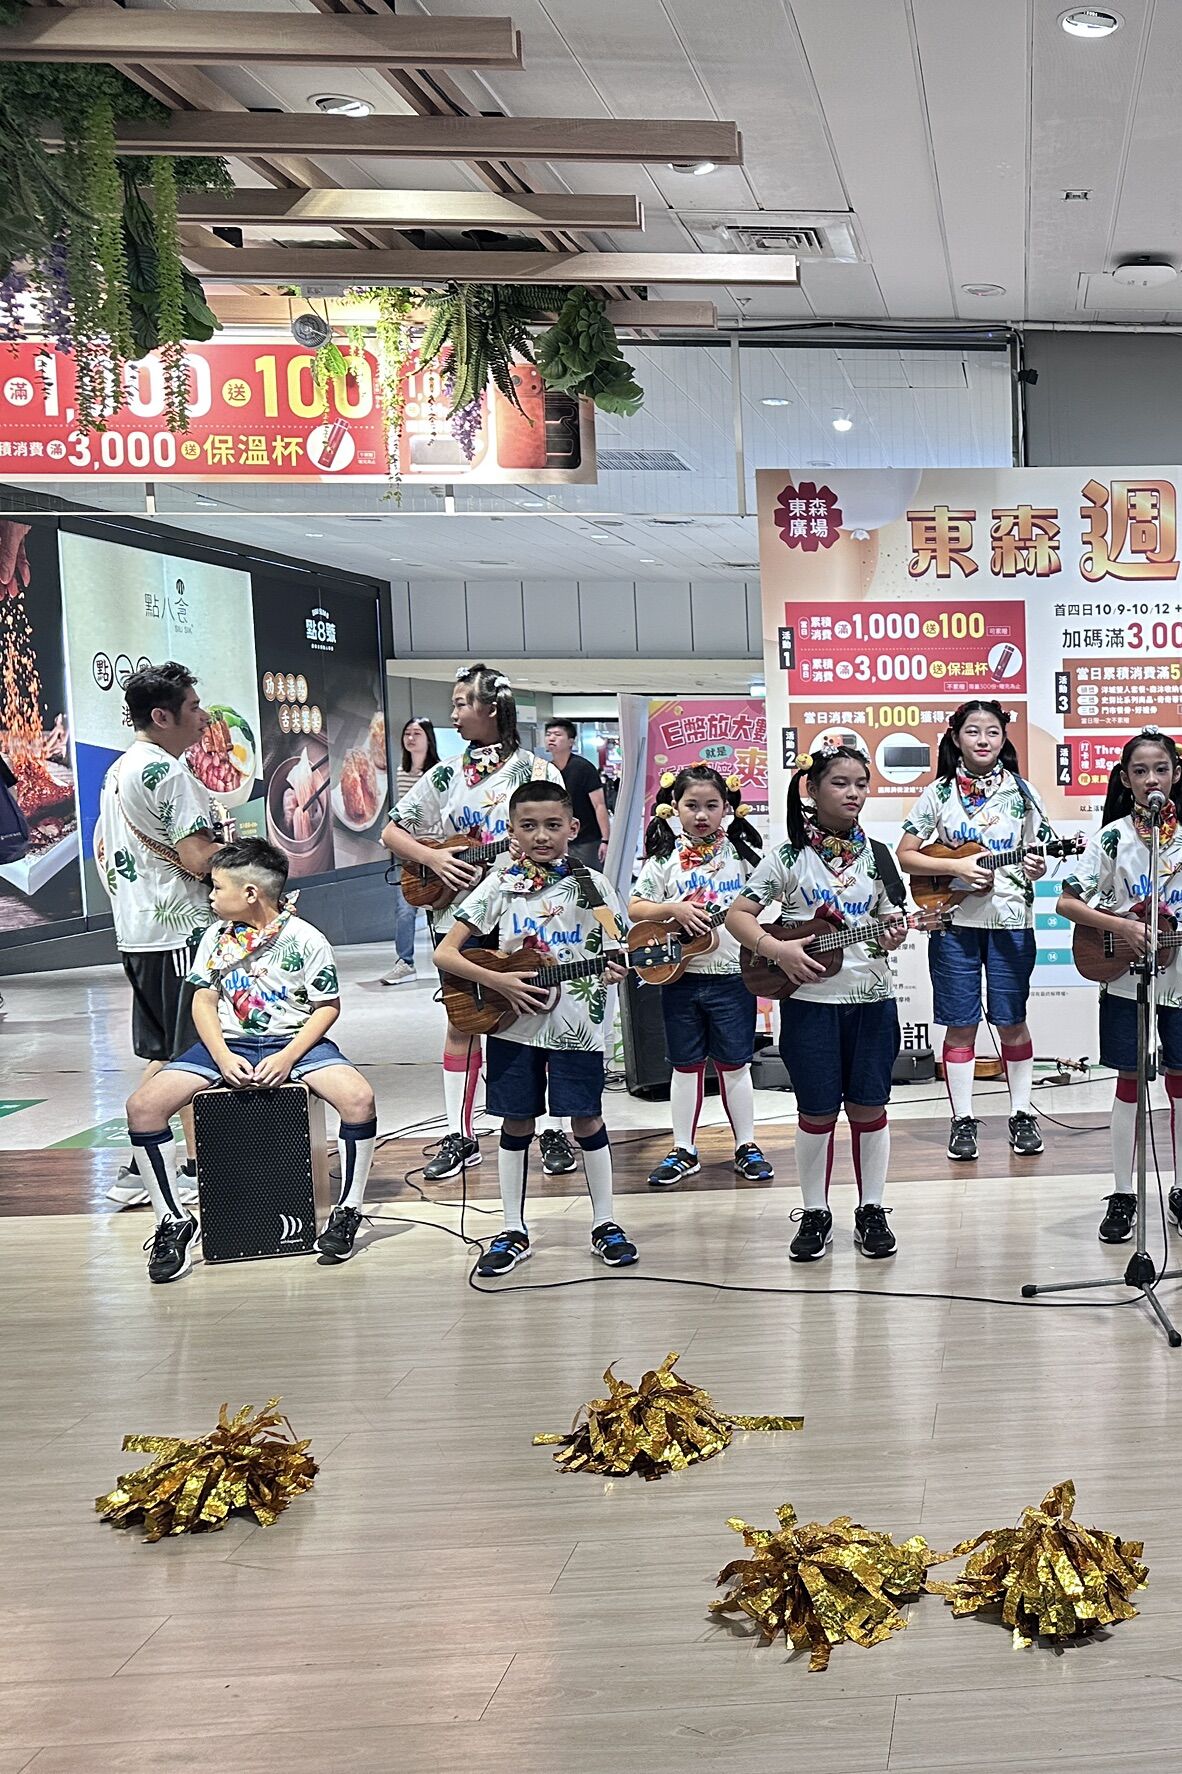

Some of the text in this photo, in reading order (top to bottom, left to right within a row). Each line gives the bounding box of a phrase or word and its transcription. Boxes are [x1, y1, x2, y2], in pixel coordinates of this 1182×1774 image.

[255, 354, 374, 419] 100
[67, 430, 177, 471] 3,000
[203, 434, 304, 467] 保溫杯
[788, 499, 828, 517] 東森
[790, 519, 829, 538] 廣場
[811, 629, 832, 641] 消費
[853, 613, 920, 641] 1,000
[939, 613, 985, 639] 100
[812, 671, 833, 682] 消費
[854, 655, 928, 684] 3,000
[947, 662, 989, 677] 保溫杯
[705, 746, 728, 758] 就是
